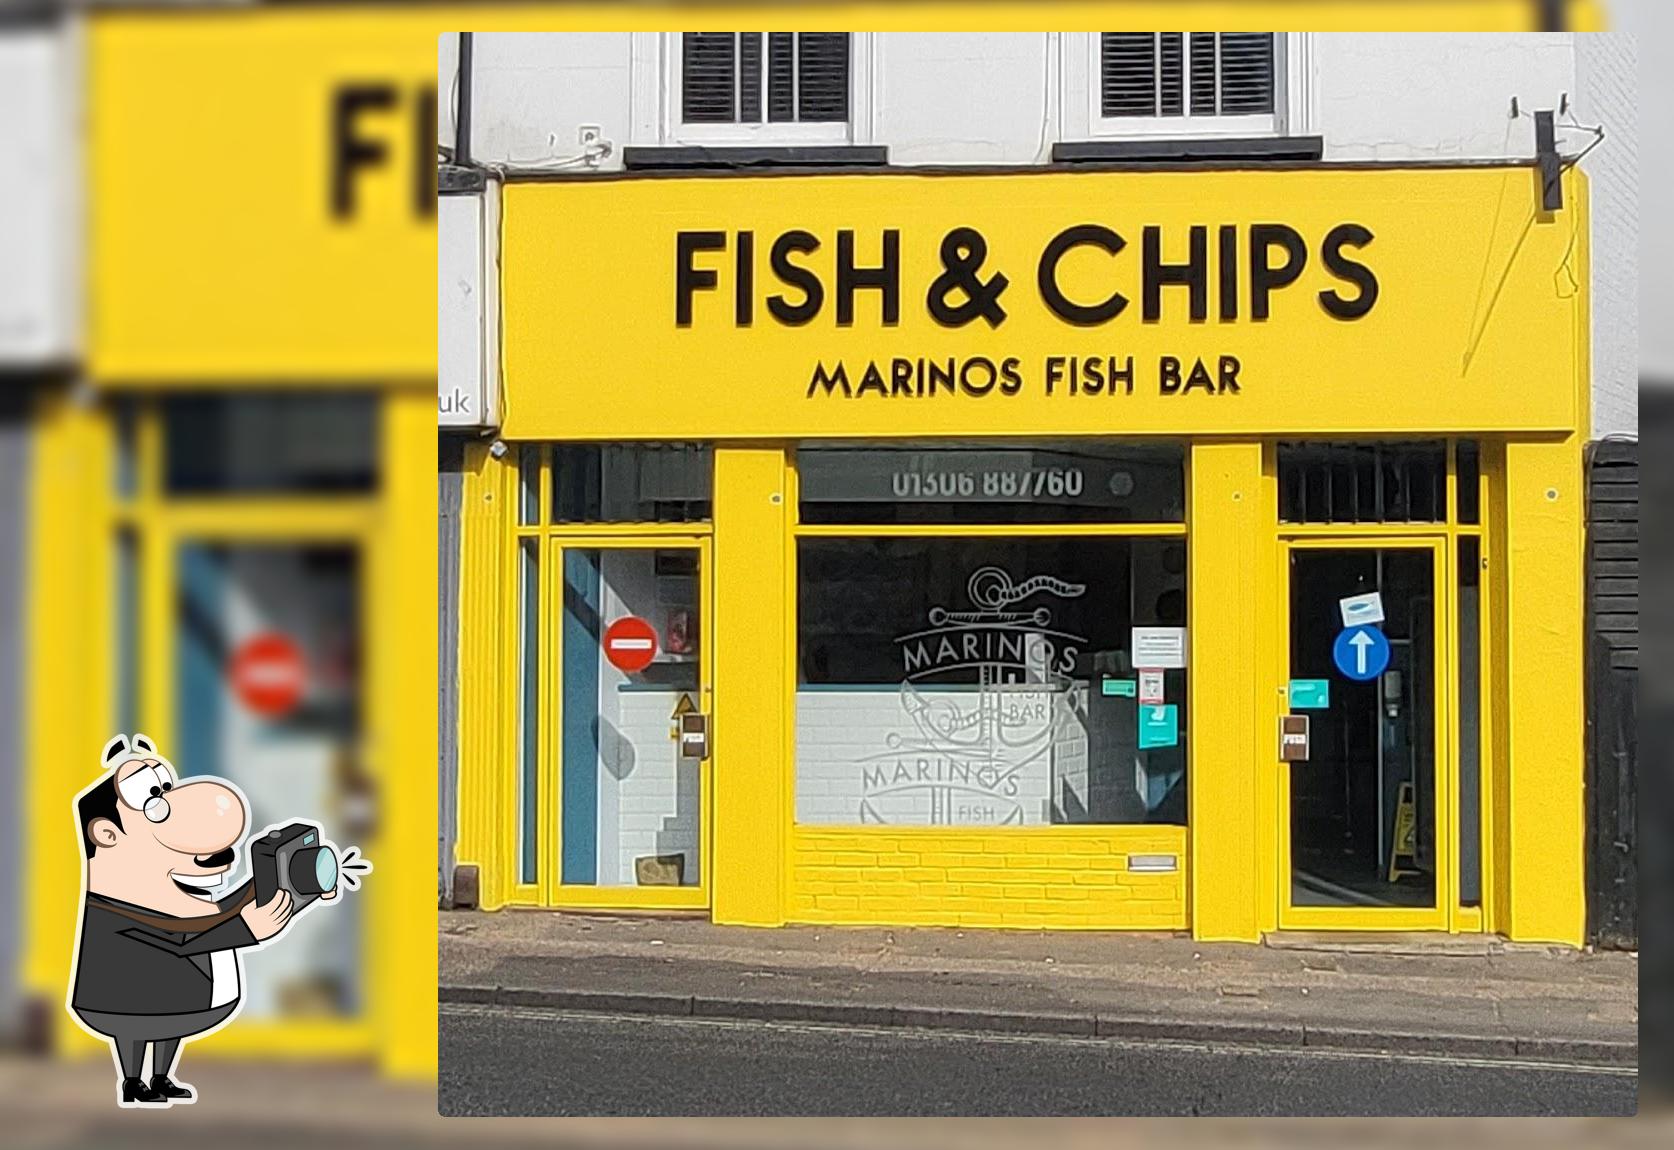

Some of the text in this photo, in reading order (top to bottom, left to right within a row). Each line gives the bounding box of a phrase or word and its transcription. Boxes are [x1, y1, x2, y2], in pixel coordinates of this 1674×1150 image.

[674, 223, 1380, 328] FISH & CHIPS
[806, 356, 1242, 399] MARINOS FISH BAR
[902, 632, 1078, 673] MARINOS
[958, 806, 995, 822] FISH
